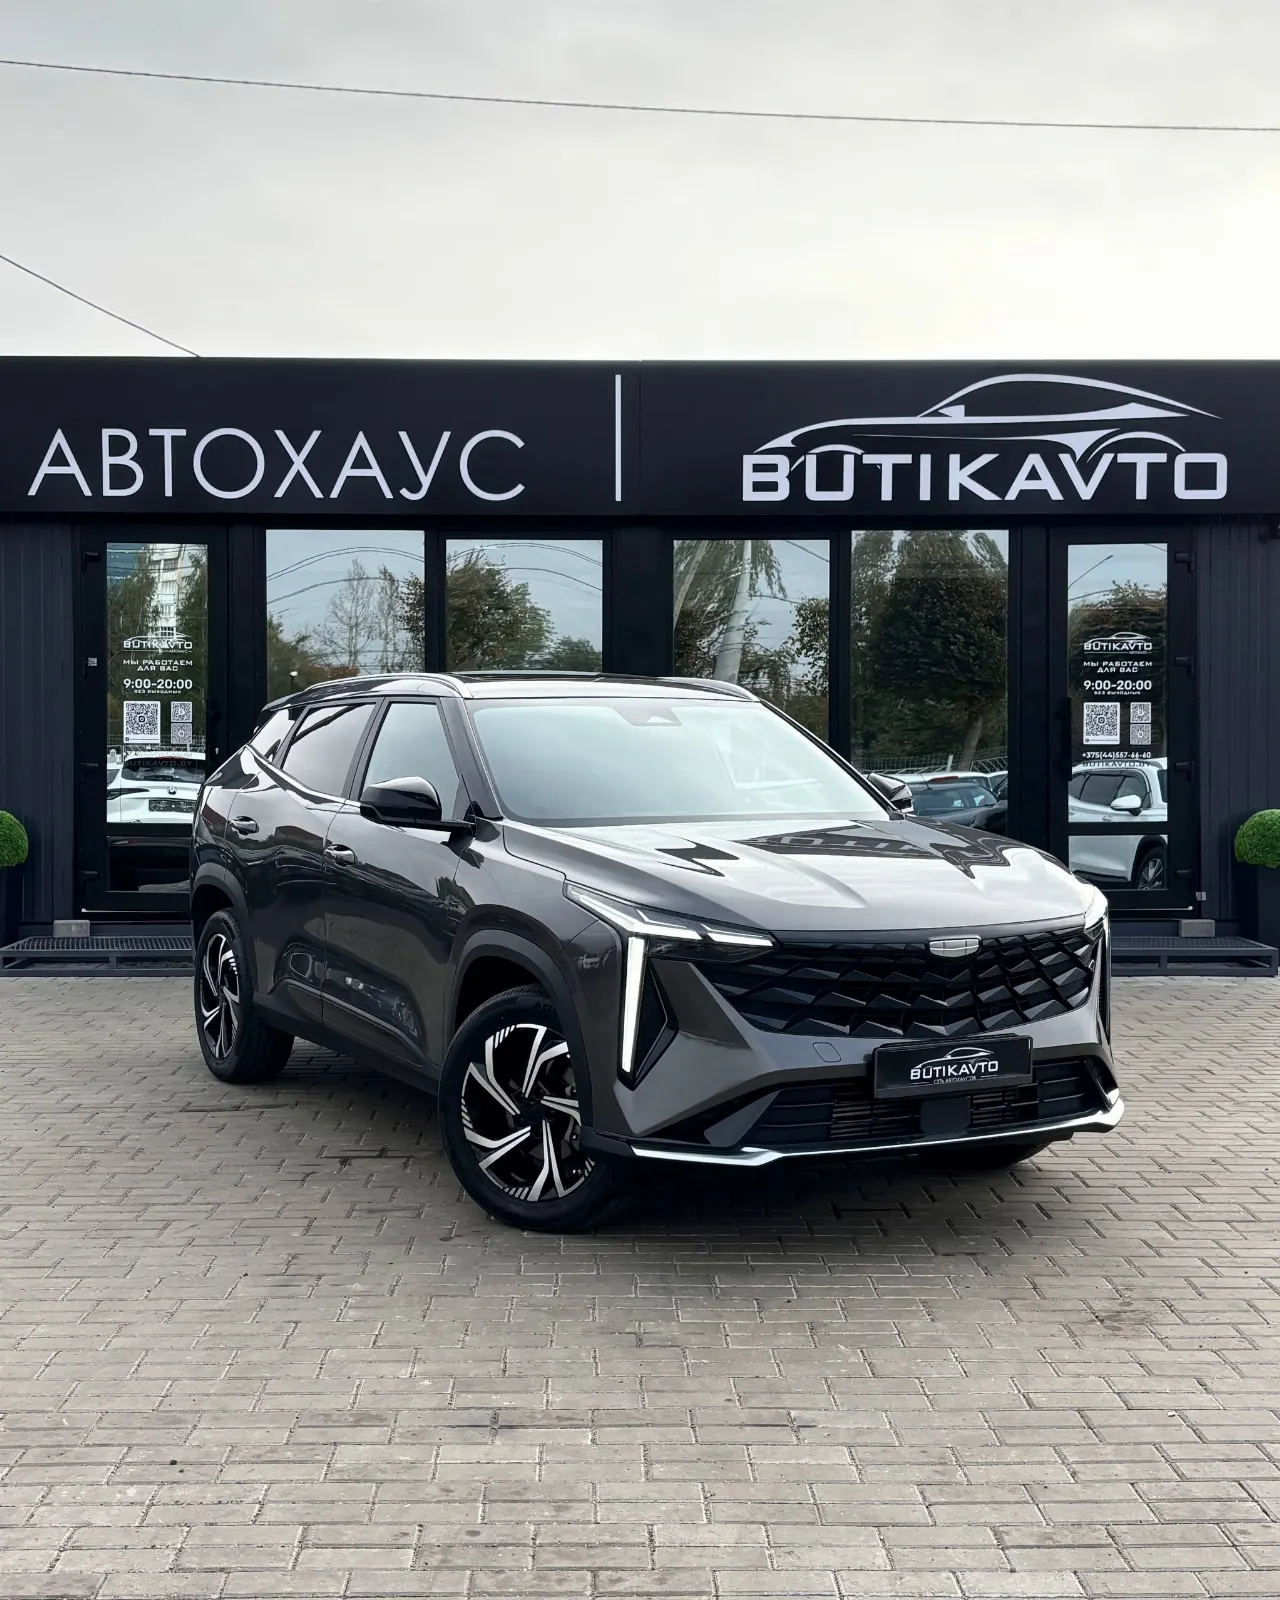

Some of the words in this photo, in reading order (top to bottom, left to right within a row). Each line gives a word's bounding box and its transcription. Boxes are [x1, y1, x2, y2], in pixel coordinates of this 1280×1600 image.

[28, 427, 525, 501] АВТОХАУС
[742, 452, 1227, 501] BUTIKAVTO
[123, 640, 193, 649] BUTIKAVTO
[1083, 642, 1152, 651] BUTIKAVTO
[123, 678, 193, 689] 9:00-20:00
[1083, 680, 1152, 690] 9:00-20:00
[1082, 751, 1151, 759] +375(44)557-66-60
[910, 1060, 999, 1080] BUTIKAVTO
